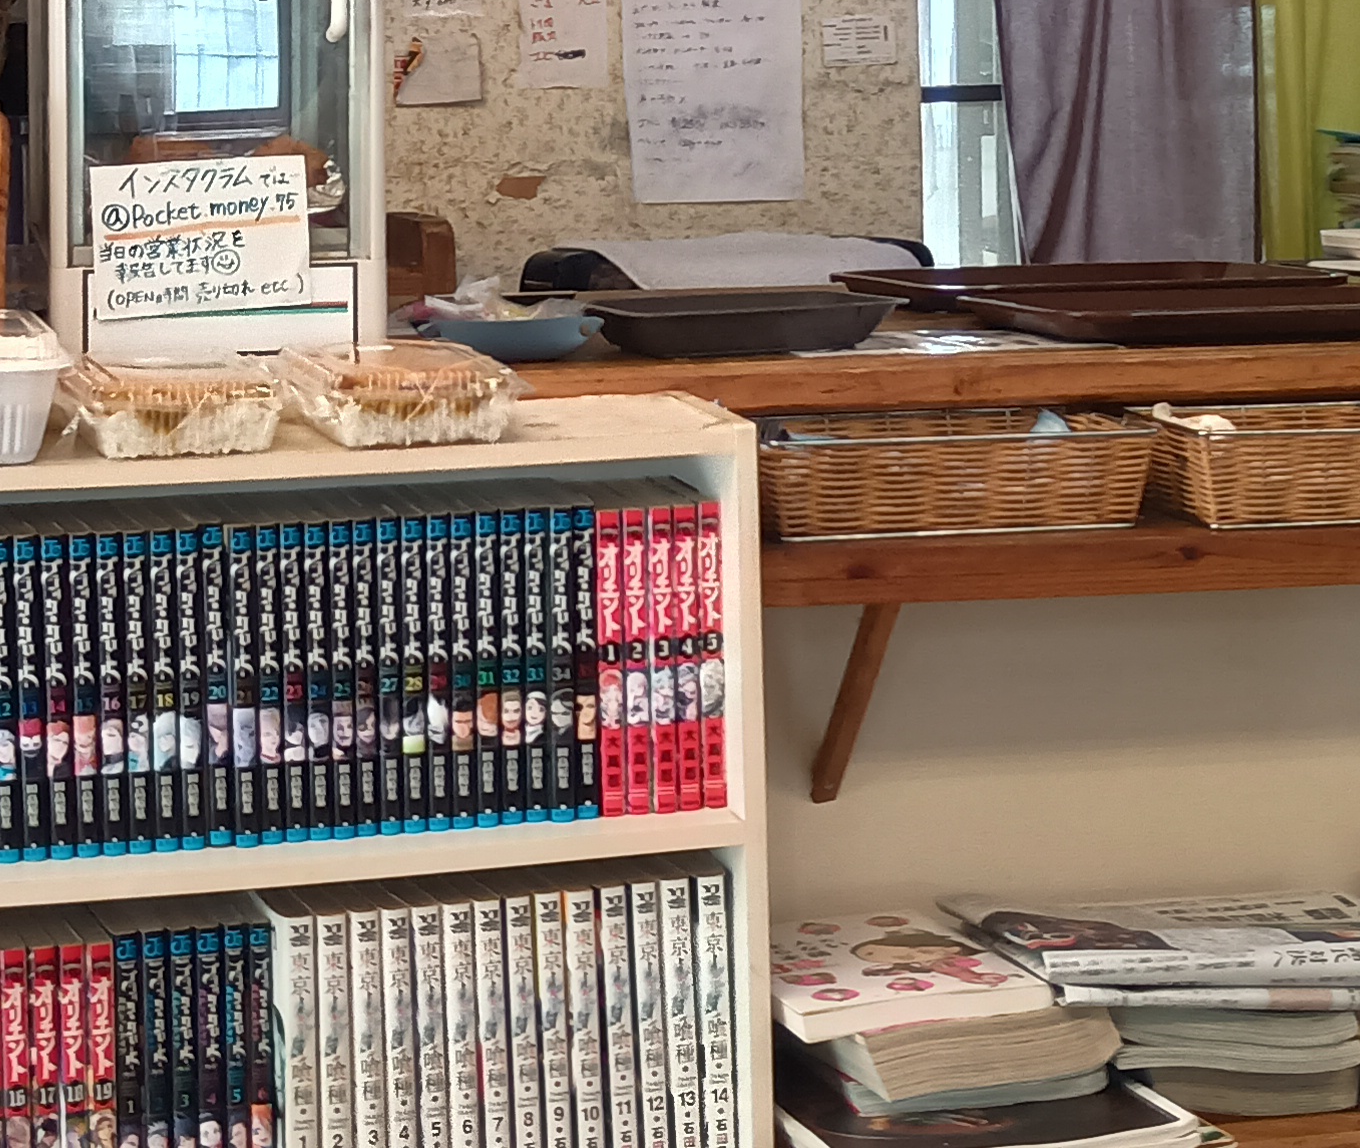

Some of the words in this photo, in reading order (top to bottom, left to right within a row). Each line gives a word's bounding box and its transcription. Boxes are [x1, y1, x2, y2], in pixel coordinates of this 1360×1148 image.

[99, 229, 246, 264] 当日の営業状況を
[624, 540, 646, 635] オリエント
[649, 537, 672, 634] オリエント
[674, 535, 697, 632] オリエント
[699, 531, 721, 629] オリエント
[598, 542, 621, 638] オリエント
[681, 637, 693, 656] 4
[706, 631, 718, 652] 5
[607, 645, 616, 661] 1
[632, 643, 643, 660] 2
[658, 642, 669, 659] 3
[1, 981, 28, 1083] オリエント
[34, 979, 58, 1081] オリエント
[89, 976, 115, 1076] オリエント
[8, 1088, 26, 1107] 16
[40, 1084, 55, 1104] 17
[96, 1081, 113, 1099] 19
[678, 1090, 696, 1107] 13
[711, 1087, 729, 1103] 14
[616, 1099, 632, 1115] 11
[646, 1095, 665, 1112] 12
[553, 1105, 565, 1122] 9
[581, 1105, 600, 1122] 10
[398, 1125, 411, 1140] 4
[431, 1121, 442, 1136] 5
[462, 1118, 473, 1135] 6
[492, 1116, 504, 1132] 7
[367, 1129, 379, 1145] 3
